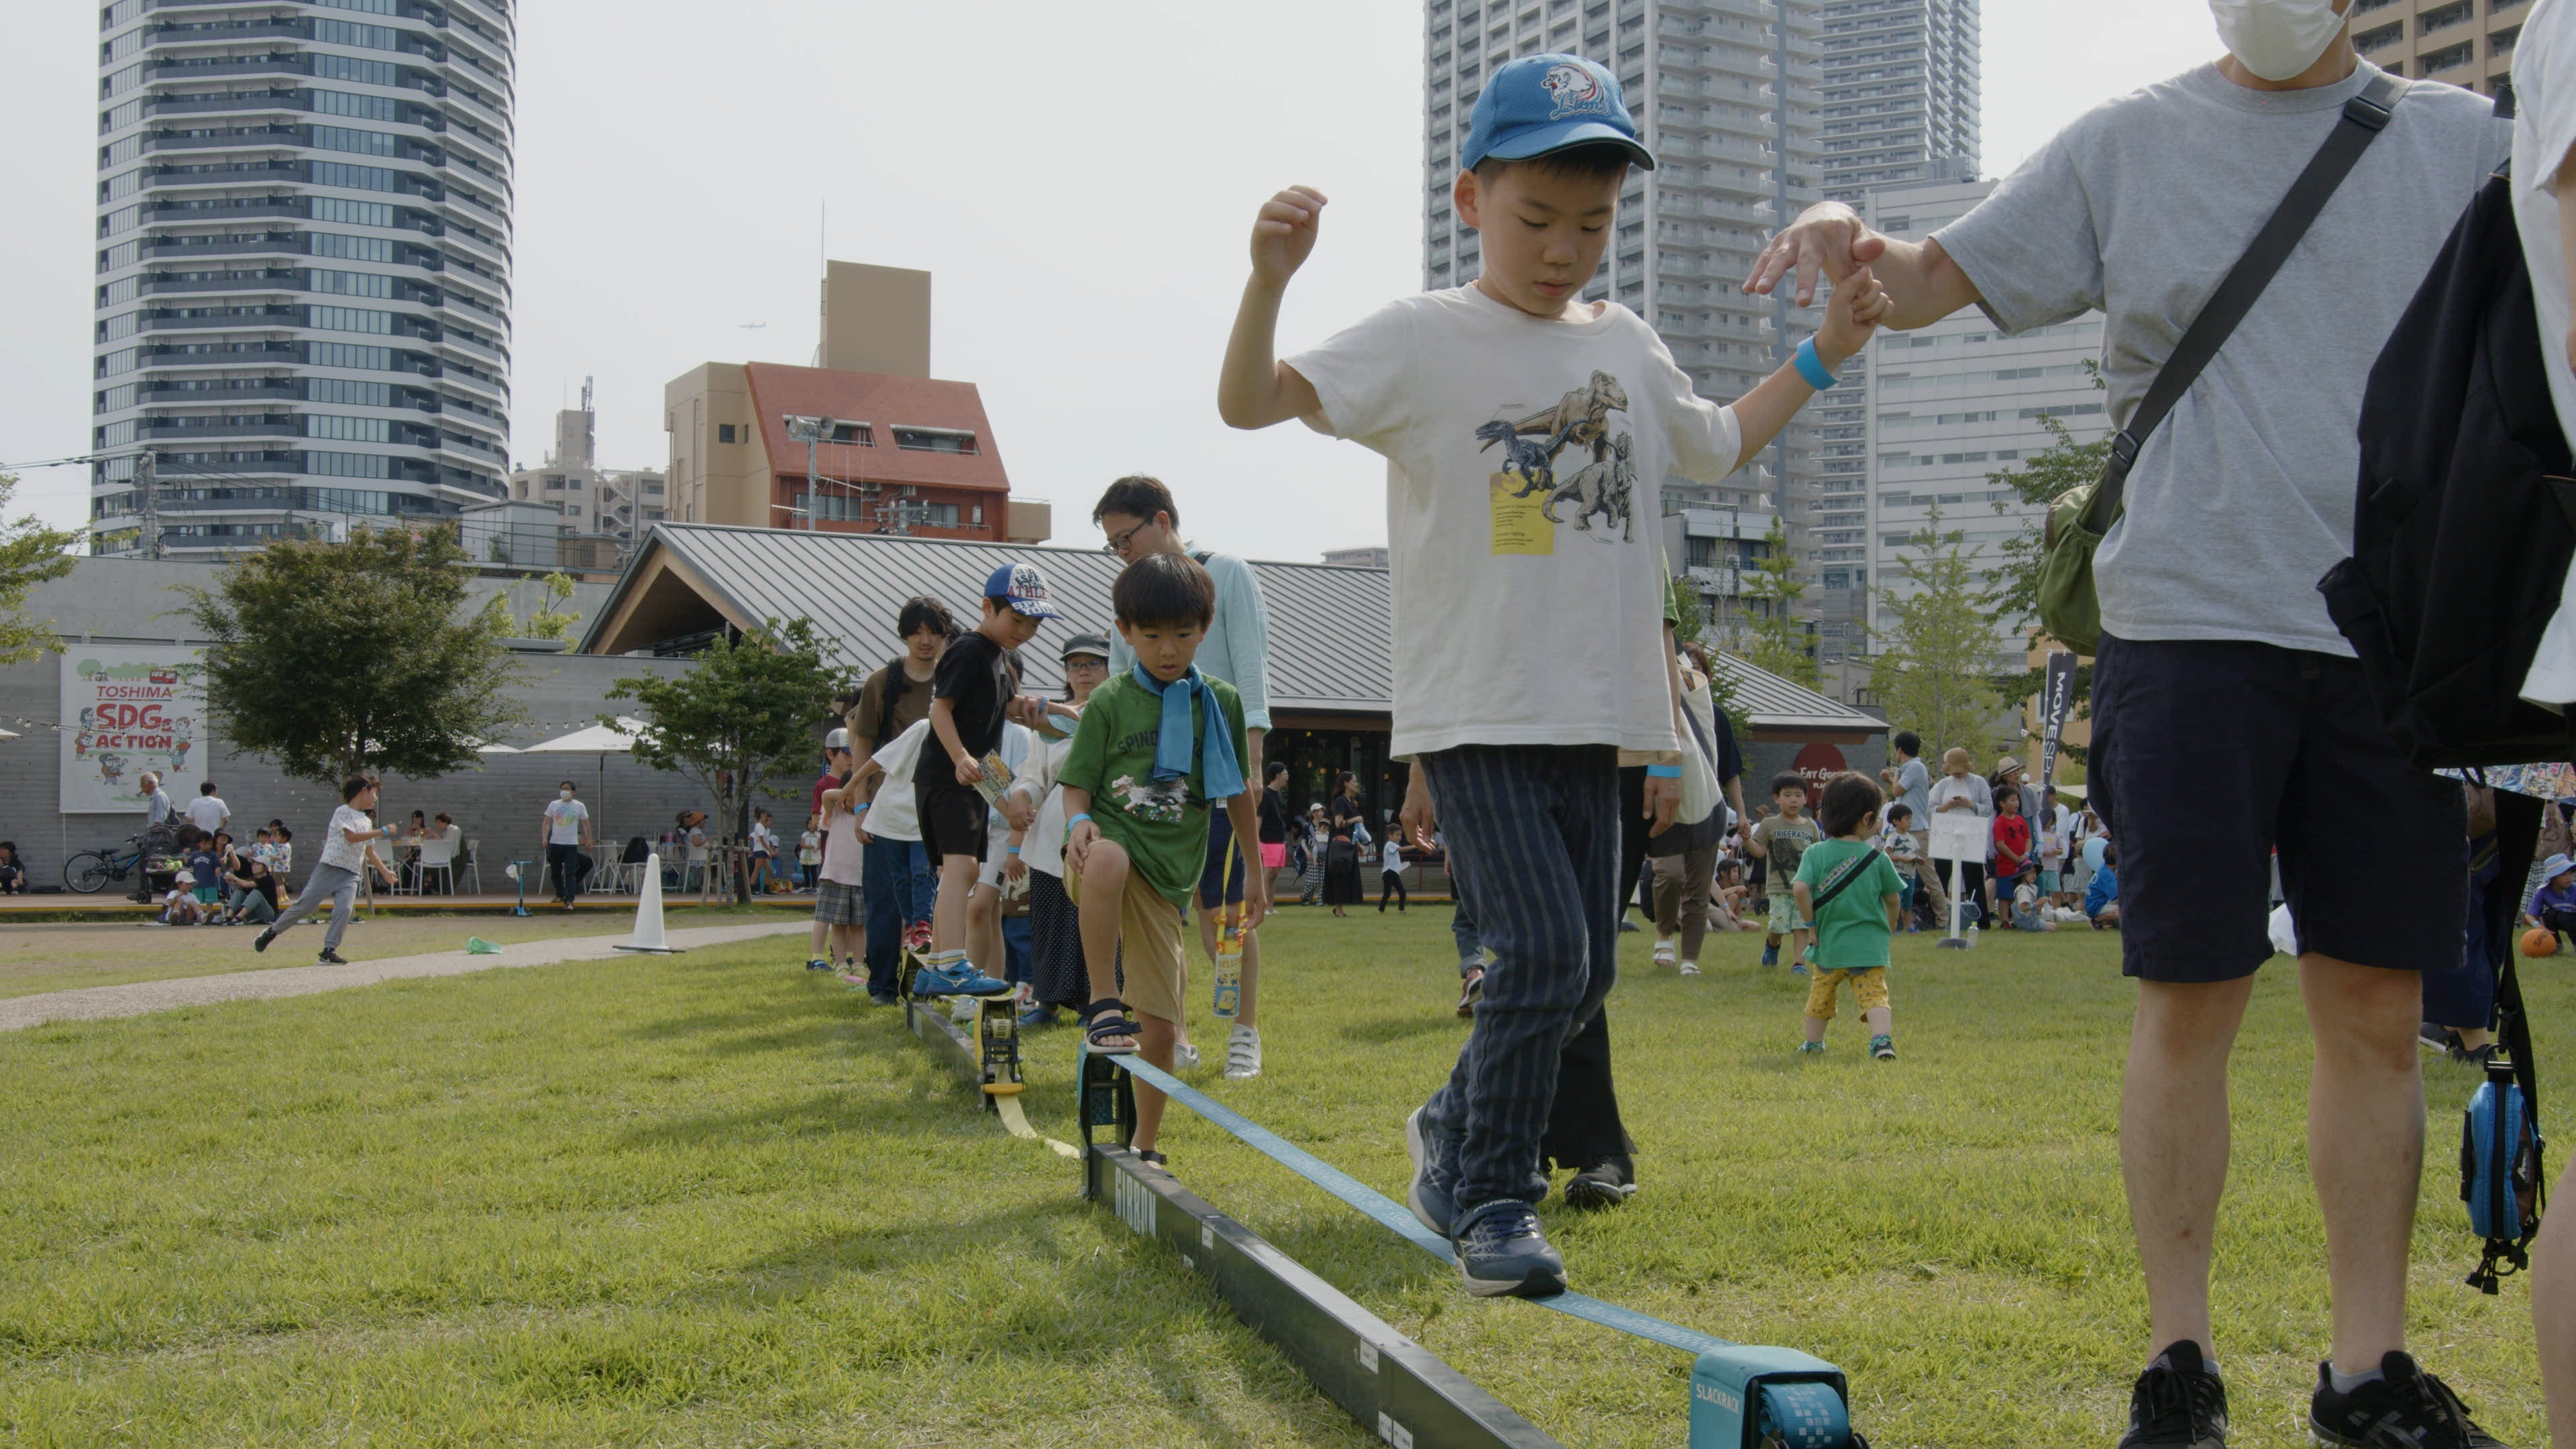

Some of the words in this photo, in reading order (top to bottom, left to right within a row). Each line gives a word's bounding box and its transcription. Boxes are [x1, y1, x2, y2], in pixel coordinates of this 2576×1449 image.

[97, 686, 172, 698] TOSHIMA
[96, 703, 172, 732] SDGs
[95, 735, 172, 749] ACTION
[1116, 1166, 1156, 1240] GIBBON
[1696, 1383, 1740, 1415] SLACKRACK
